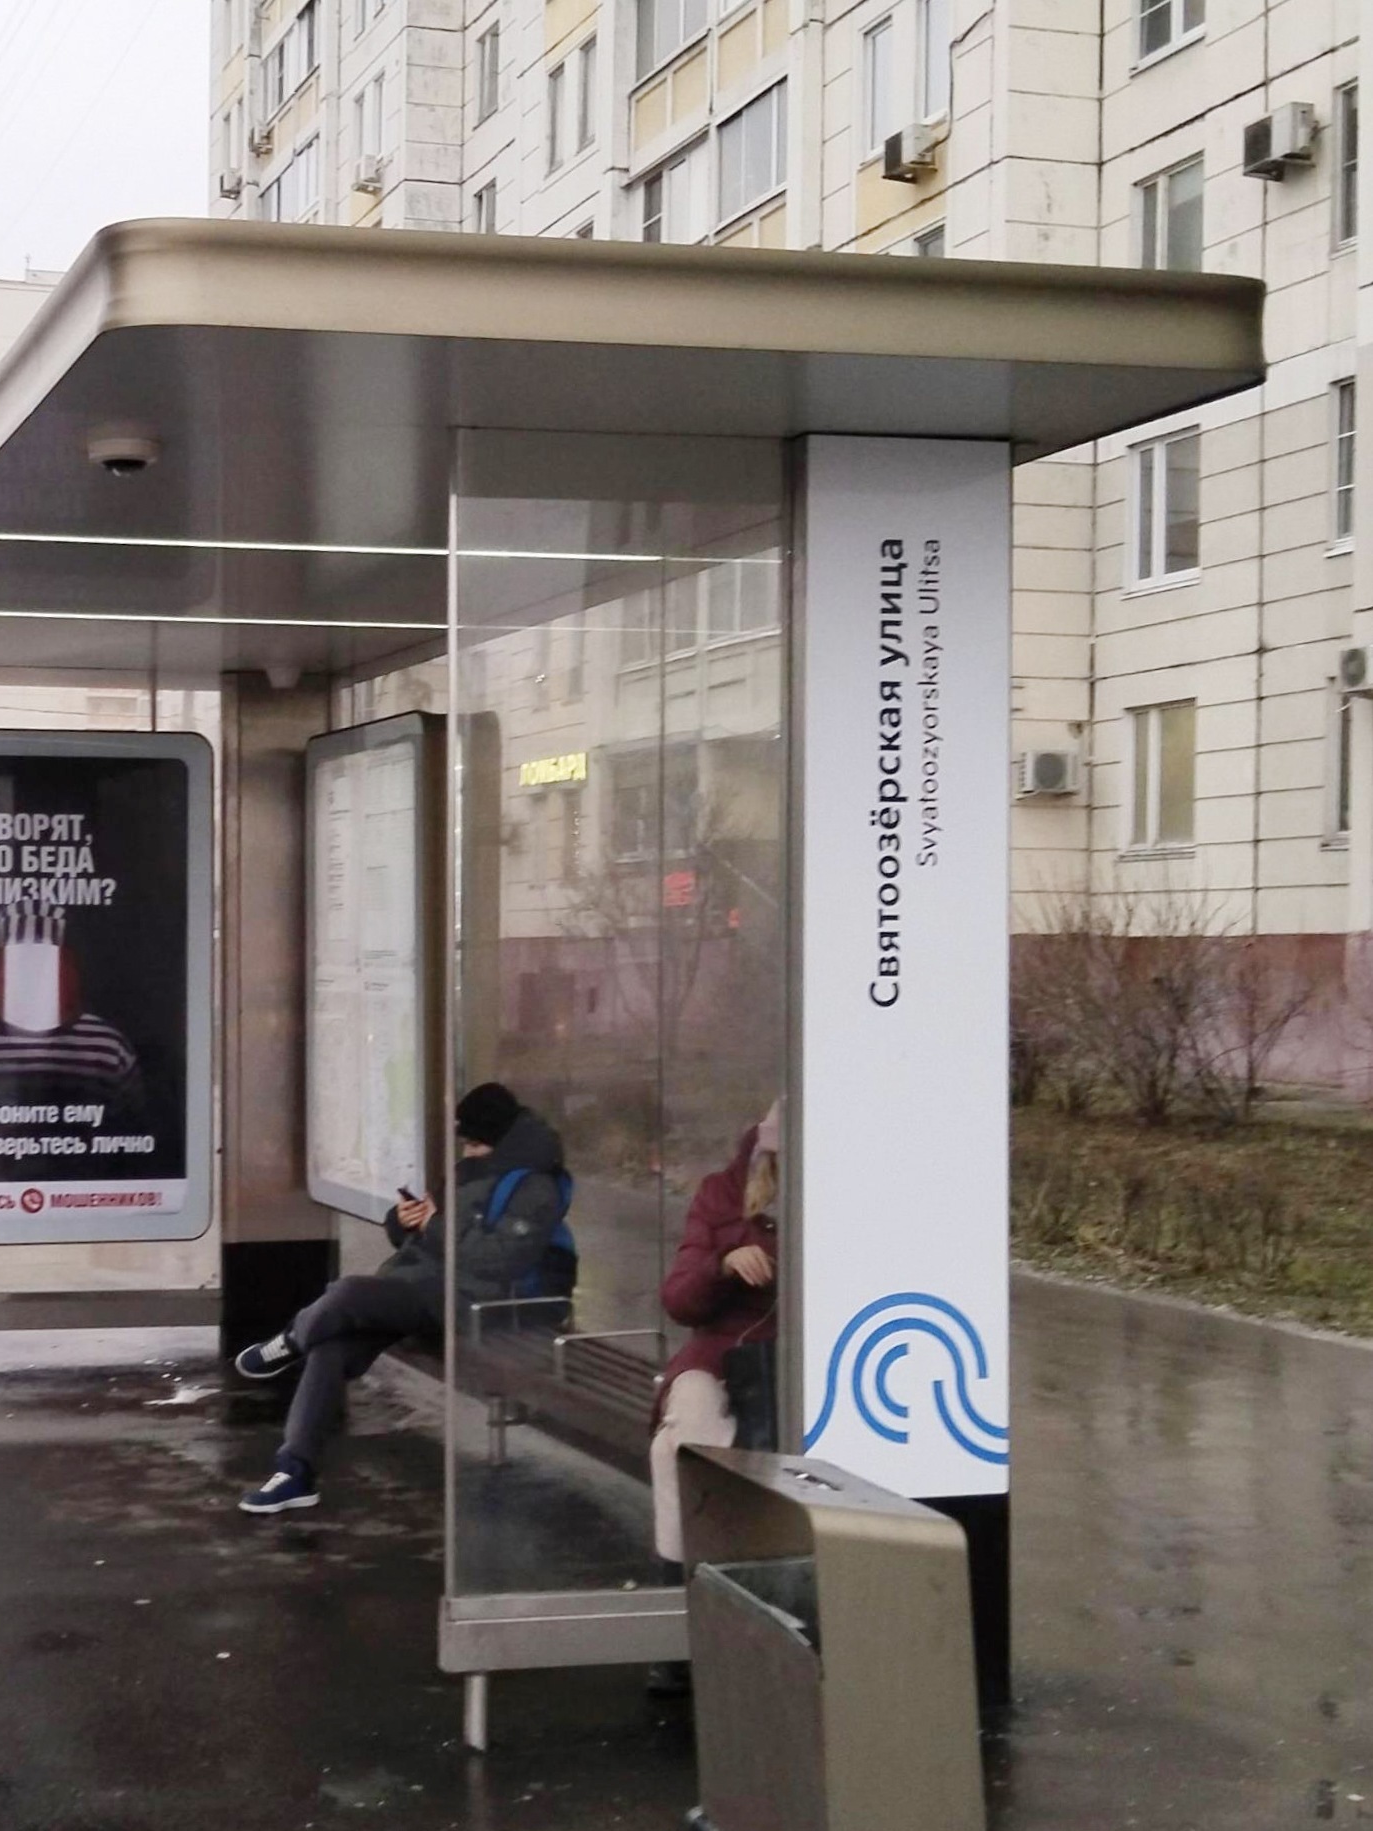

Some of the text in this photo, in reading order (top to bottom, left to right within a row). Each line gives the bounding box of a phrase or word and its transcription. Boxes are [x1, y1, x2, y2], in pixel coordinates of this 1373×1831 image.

[917, 538, 944, 867] Svyatoozyorskaya Ulitsa
[870, 538, 910, 1008] Святоозёрская улица
[21, 844, 95, 878] БЕДА
[63, 1104, 105, 1127] ему
[91, 1133, 156, 1154] лично
[50, 1191, 163, 1209] МОШЕННИКОВ!
